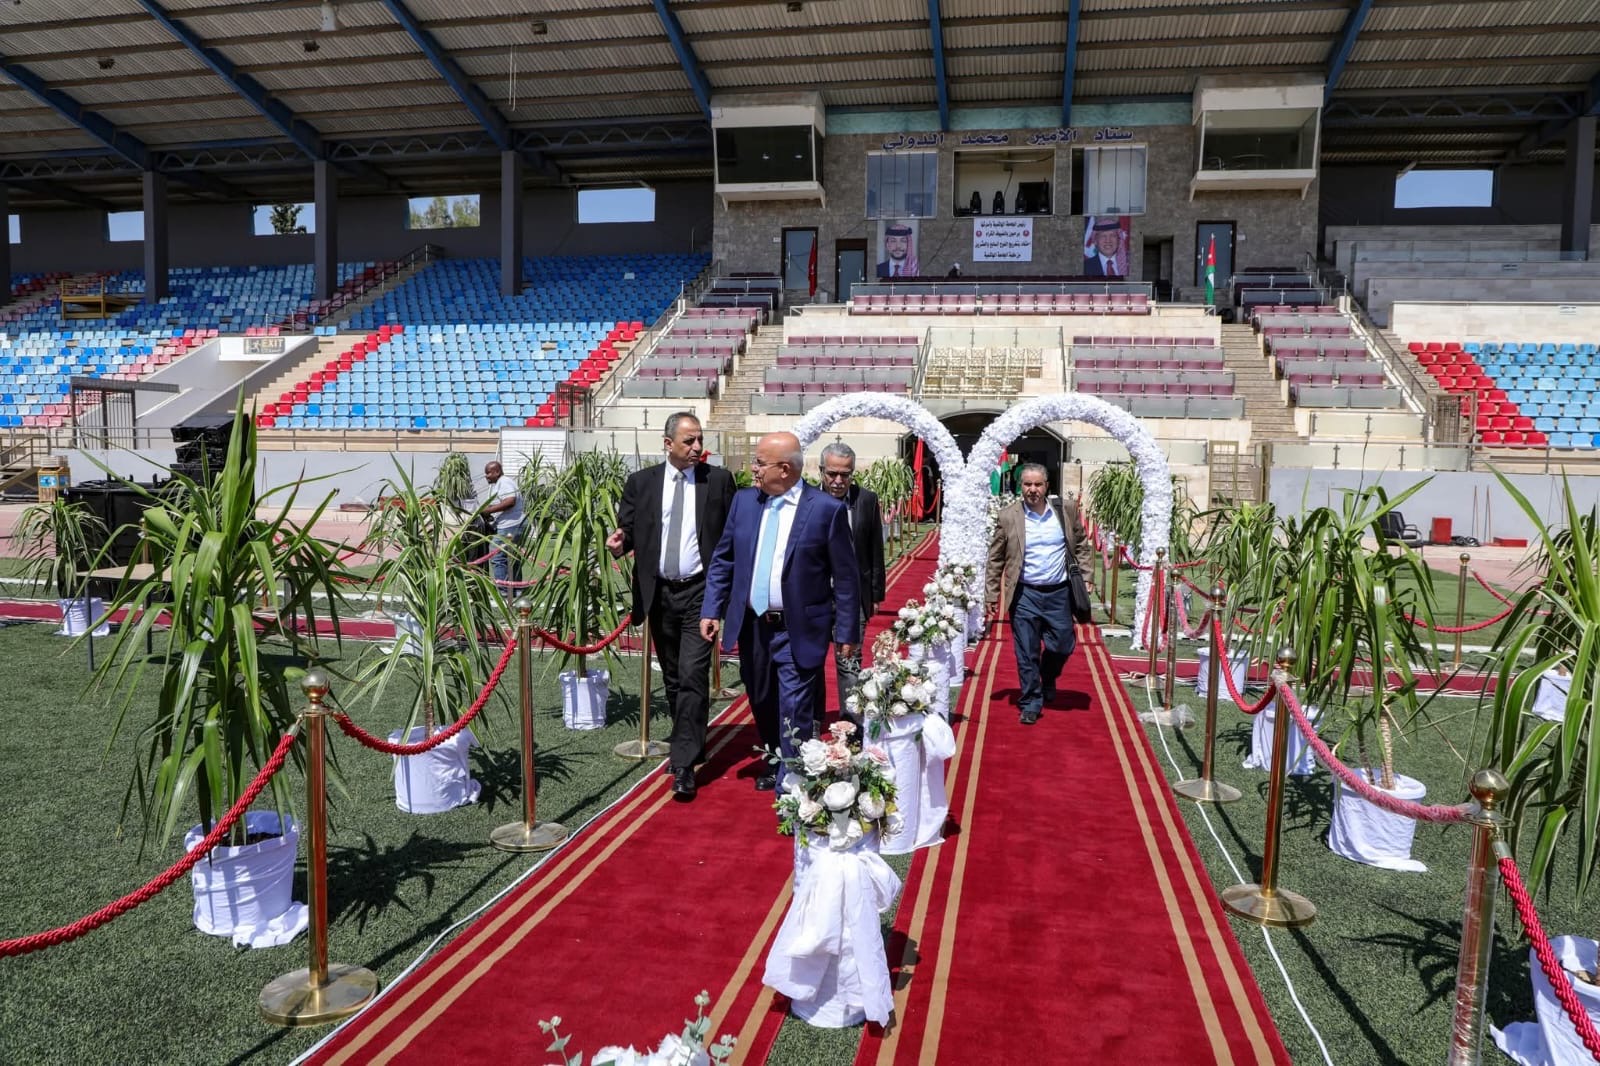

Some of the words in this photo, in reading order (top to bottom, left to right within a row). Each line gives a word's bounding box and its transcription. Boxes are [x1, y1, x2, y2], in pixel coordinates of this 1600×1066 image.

[961, 132, 1009, 145] محمد
[1094, 128, 1133, 141] ستاد
[882, 134, 945, 151] الدولي
[261, 338, 283, 348] EXIT
